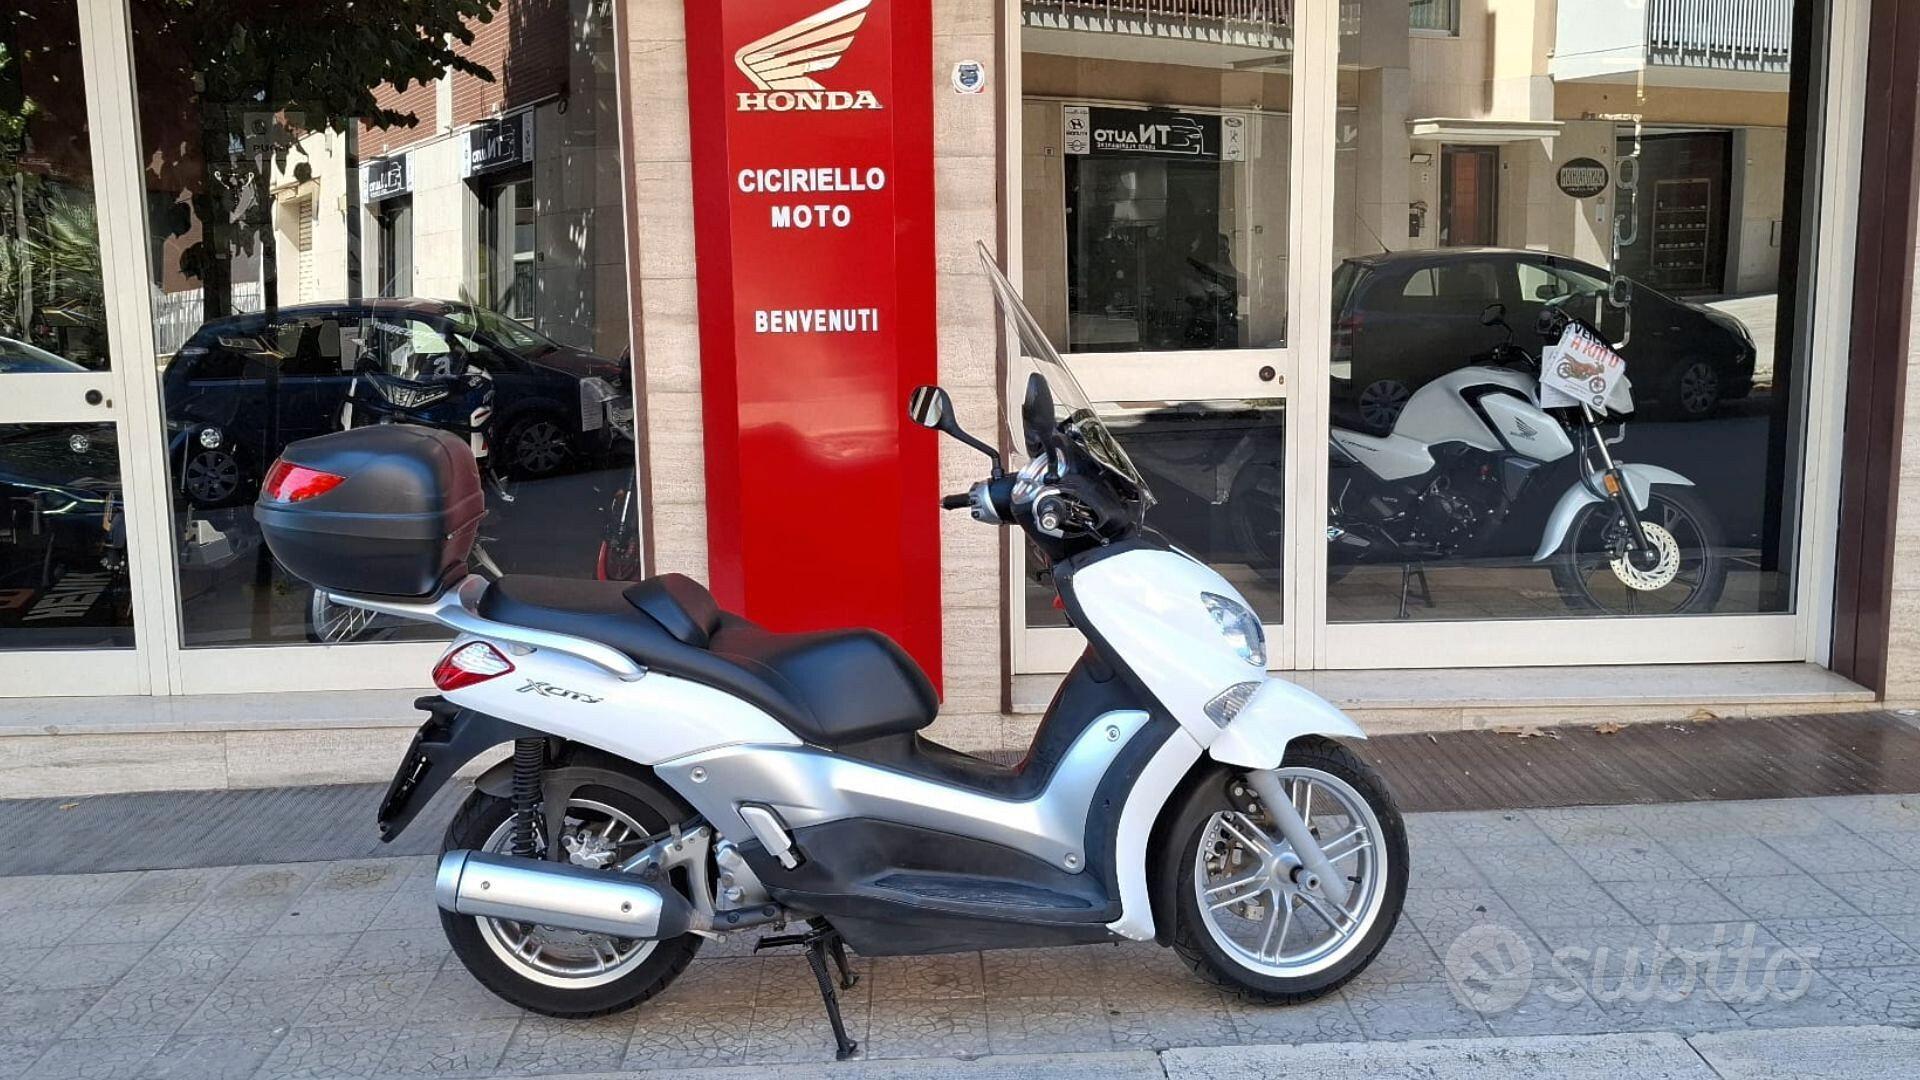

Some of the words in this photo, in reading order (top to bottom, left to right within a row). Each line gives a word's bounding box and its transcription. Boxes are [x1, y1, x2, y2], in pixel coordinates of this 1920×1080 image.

[736, 90, 884, 111] HONDA
[737, 167, 886, 193] CICIRIELLO
[771, 205, 851, 229] MOTO
[754, 308, 878, 333] BENVENUTI
